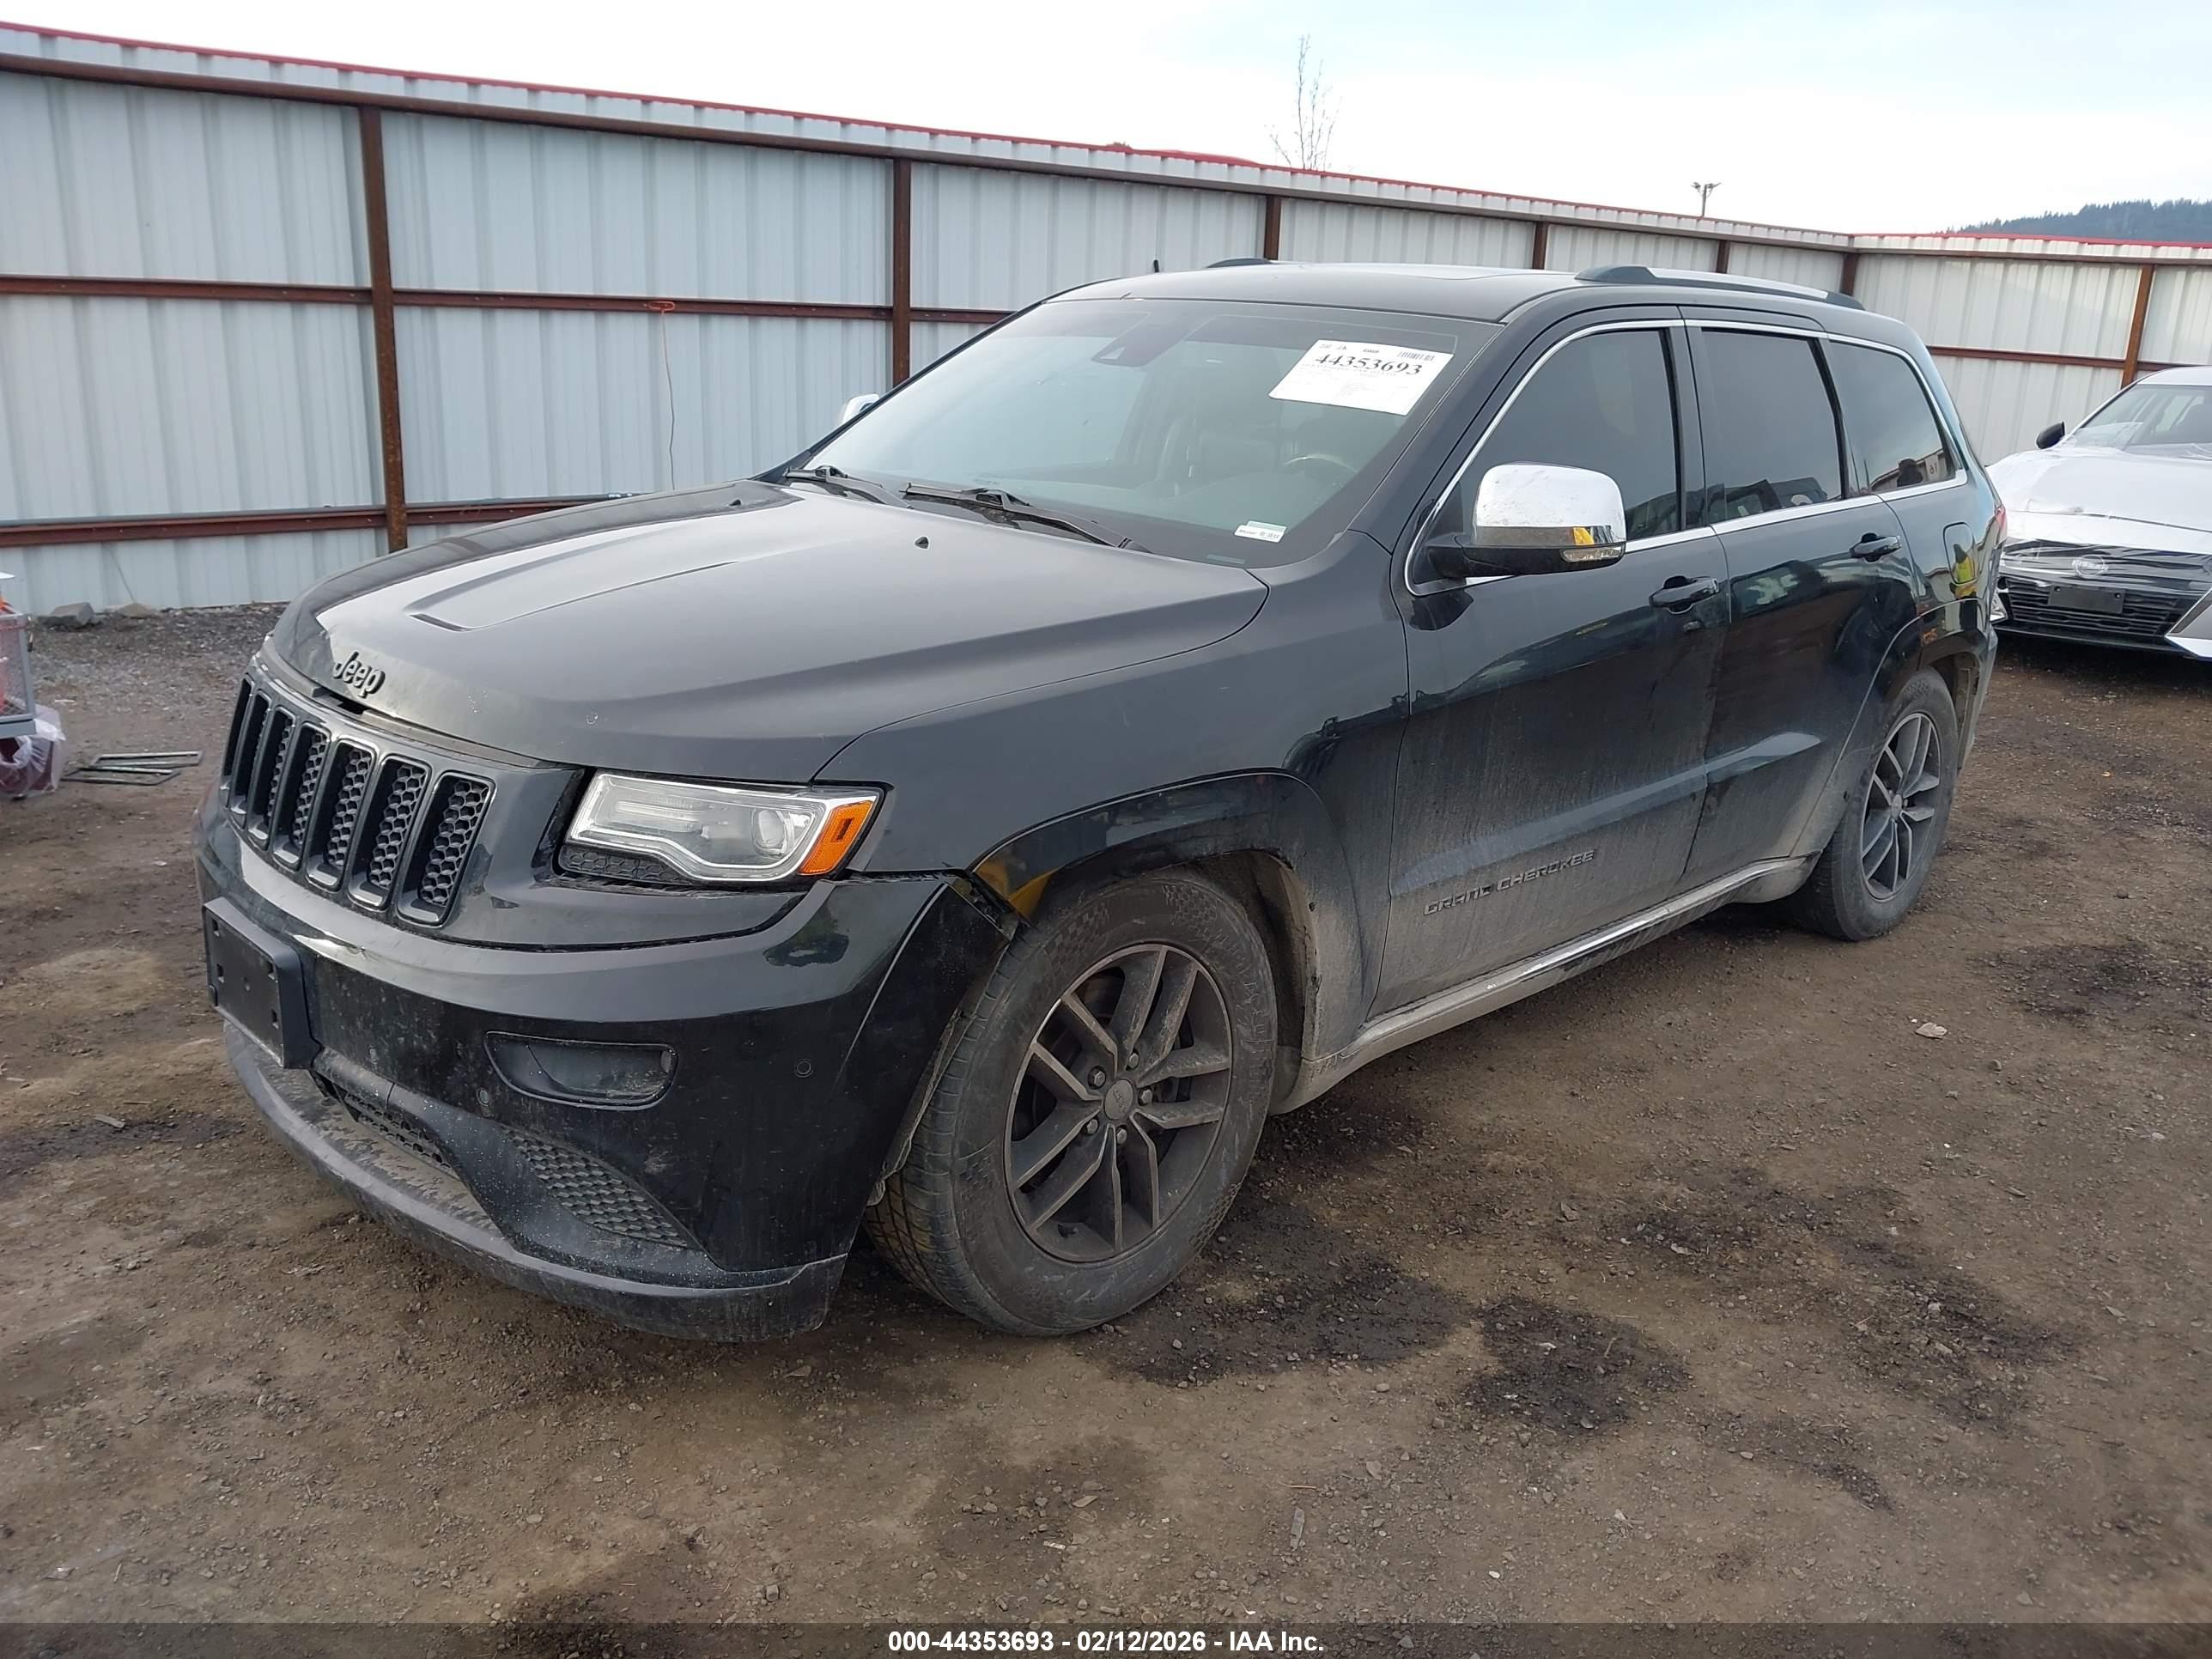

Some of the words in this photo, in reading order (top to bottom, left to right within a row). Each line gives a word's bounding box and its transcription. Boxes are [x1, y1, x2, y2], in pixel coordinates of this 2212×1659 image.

[1315, 353, 1423, 375] 44353693
[331, 650, 386, 699] Jeep
[1423, 884, 1493, 916] GRAND
[1496, 849, 1595, 891] CHEROKEE
